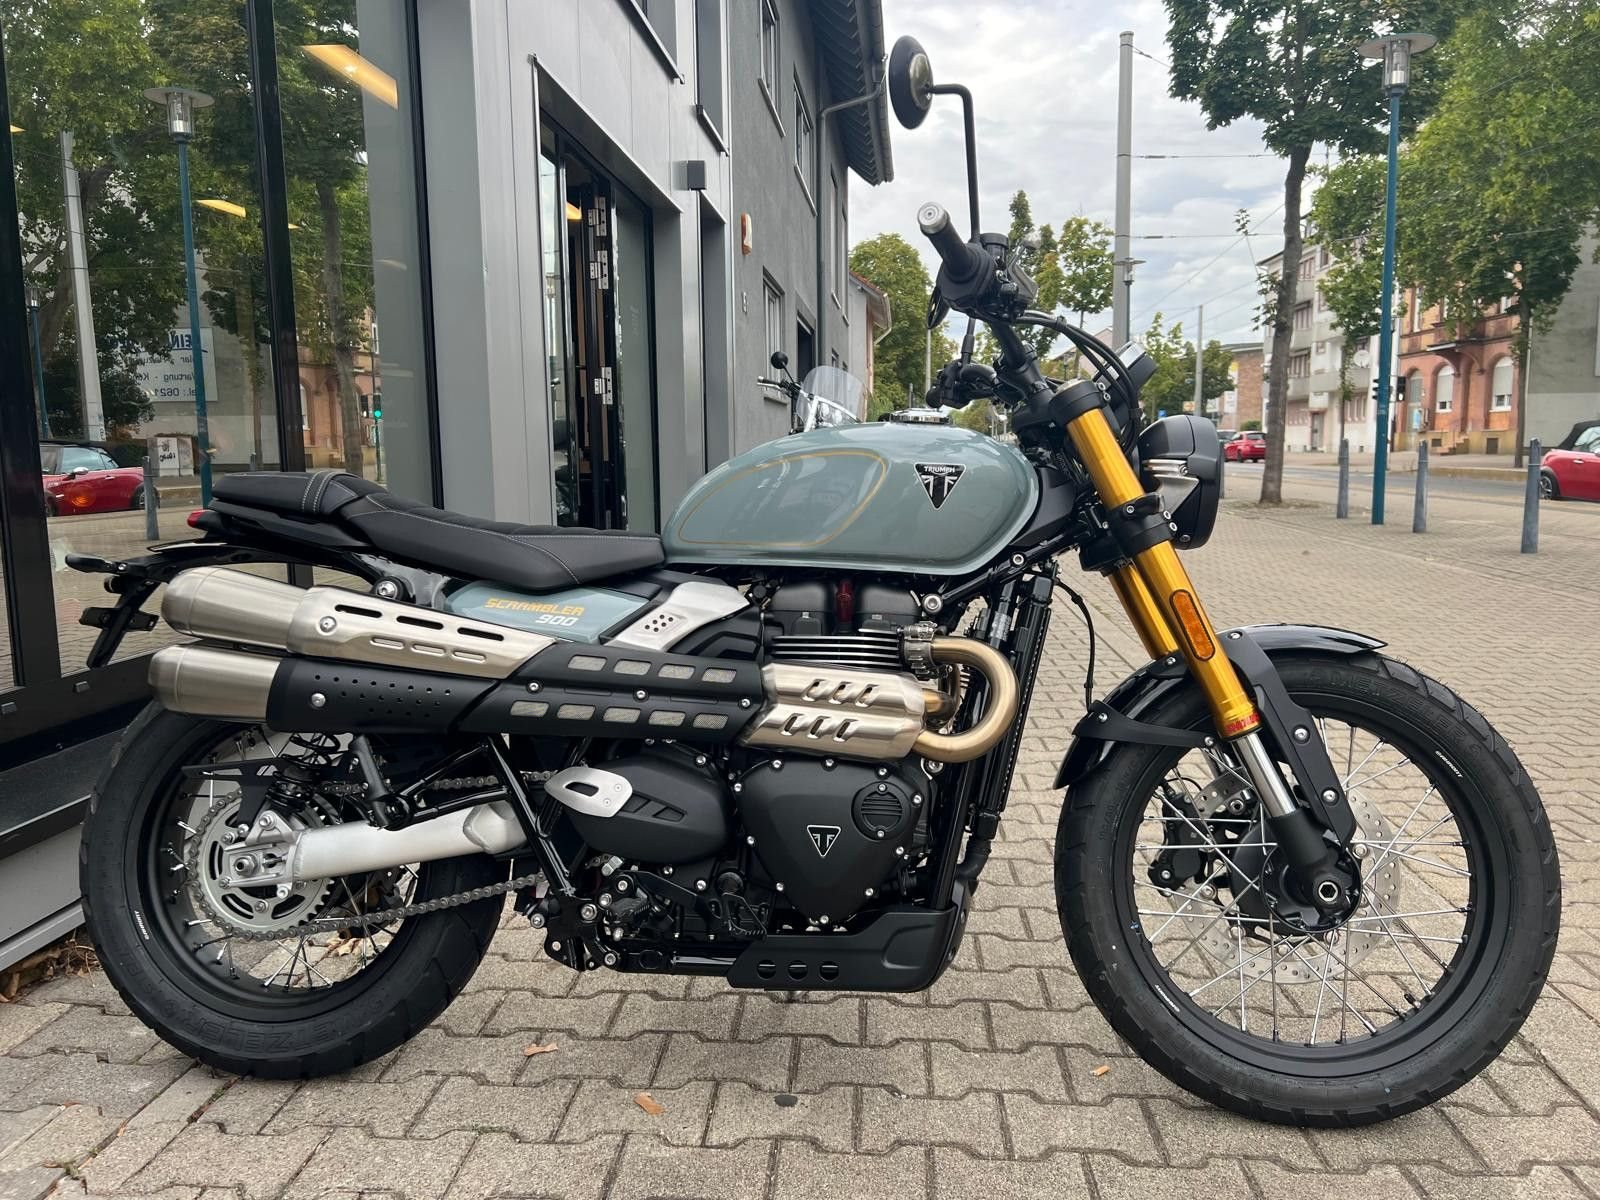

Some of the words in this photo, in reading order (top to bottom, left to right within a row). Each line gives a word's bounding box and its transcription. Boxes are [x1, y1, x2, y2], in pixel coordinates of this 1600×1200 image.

[923, 465, 955, 474] TRIUMPH
[484, 598, 585, 617] SCRAMBLER
[535, 614, 579, 627] 900
